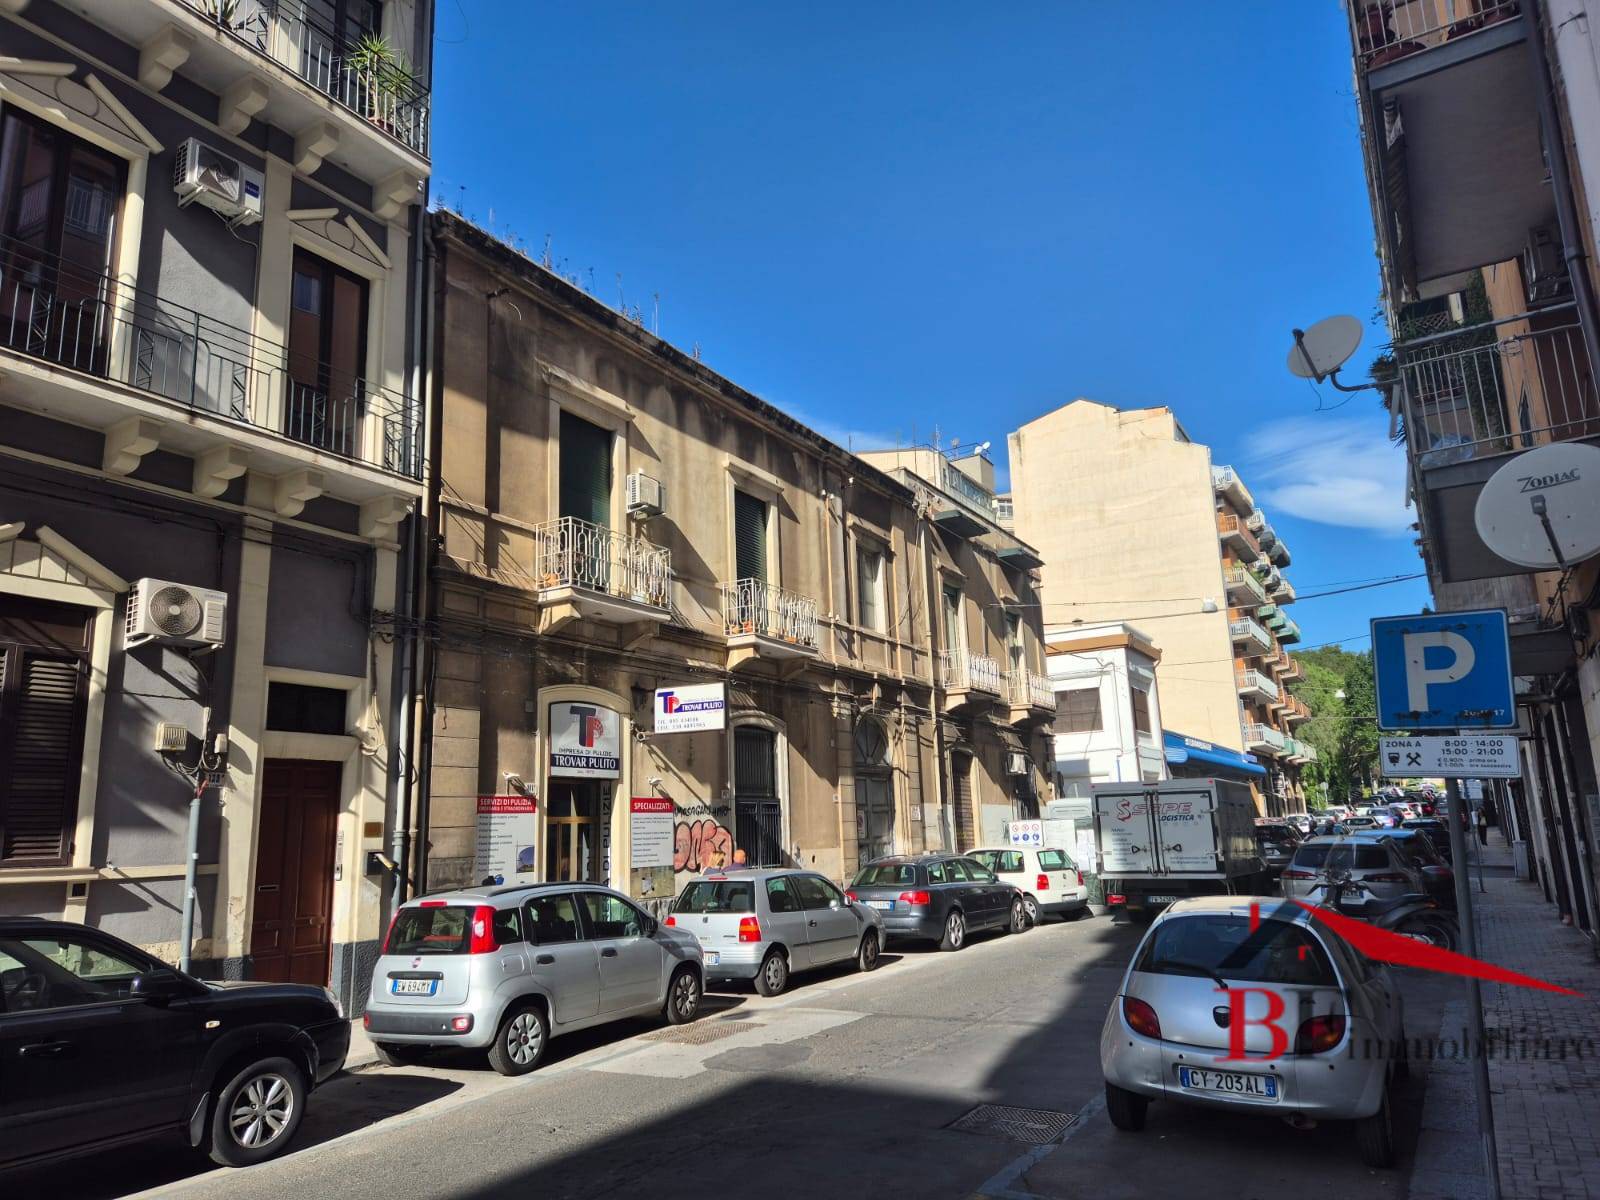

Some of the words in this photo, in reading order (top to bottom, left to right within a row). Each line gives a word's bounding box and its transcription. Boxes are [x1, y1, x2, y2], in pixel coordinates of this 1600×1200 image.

[1516, 468, 1580, 493] ZODIAC
[1403, 631, 1475, 712] P
[682, 703, 703, 711] TROVAR
[703, 702, 723, 710] PULITO
[554, 755, 587, 768] TROVAR
[589, 757, 616, 769] PULITO
[480, 798, 503, 806] SERVIZI
[503, 798, 510, 806] DI
[511, 798, 532, 806] PULIZIA
[634, 802, 670, 810] SPECIALIZZATI
[1190, 1070, 1208, 1087] CY
[1215, 1073, 1265, 1094] 203AL
